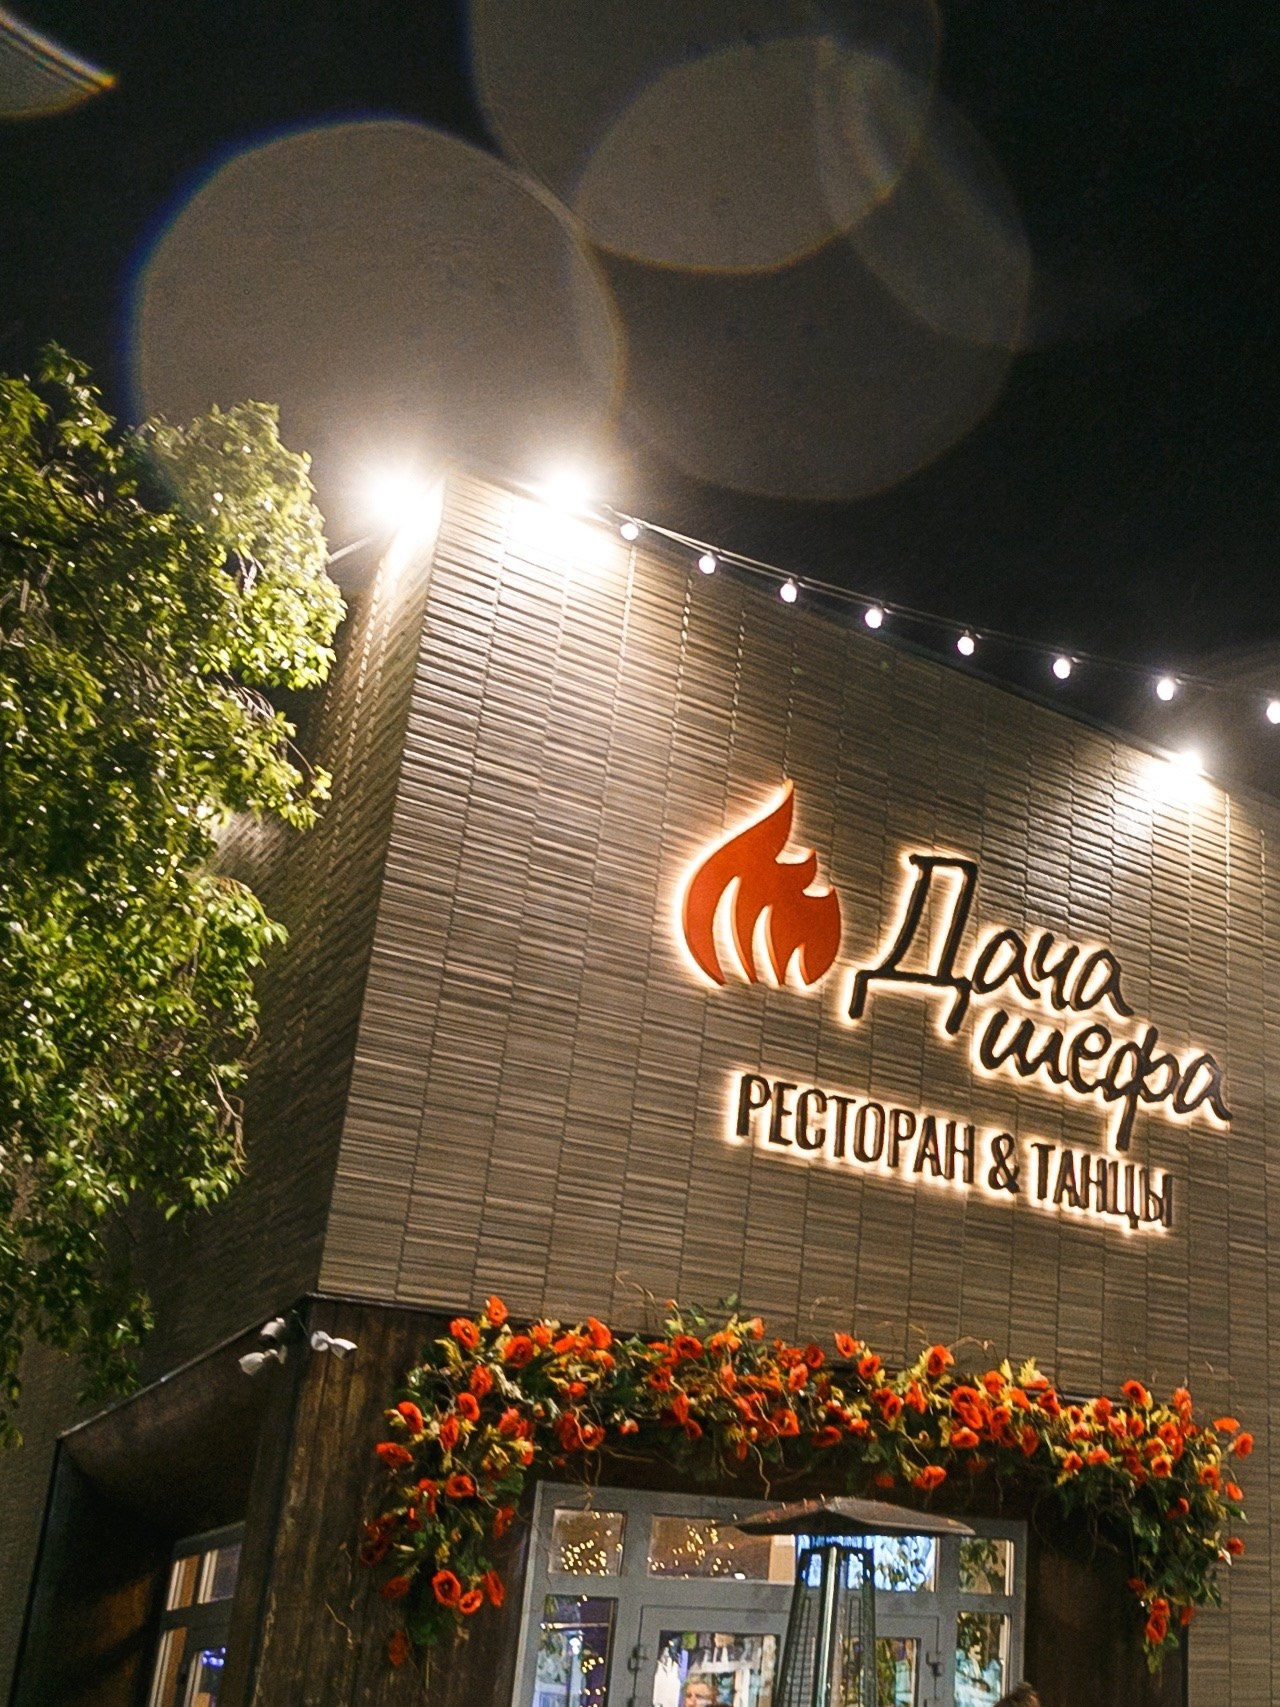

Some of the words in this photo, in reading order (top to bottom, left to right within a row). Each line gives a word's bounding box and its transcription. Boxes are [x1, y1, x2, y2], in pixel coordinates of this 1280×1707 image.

[848, 853, 1134, 1035] Дача
[735, 1073, 975, 1184] РЕСТОРАН
[988, 1133, 1020, 1194] &
[1031, 1141, 1173, 1229] ТАНЦЫ
[979, 1009, 1232, 1151] шефа
